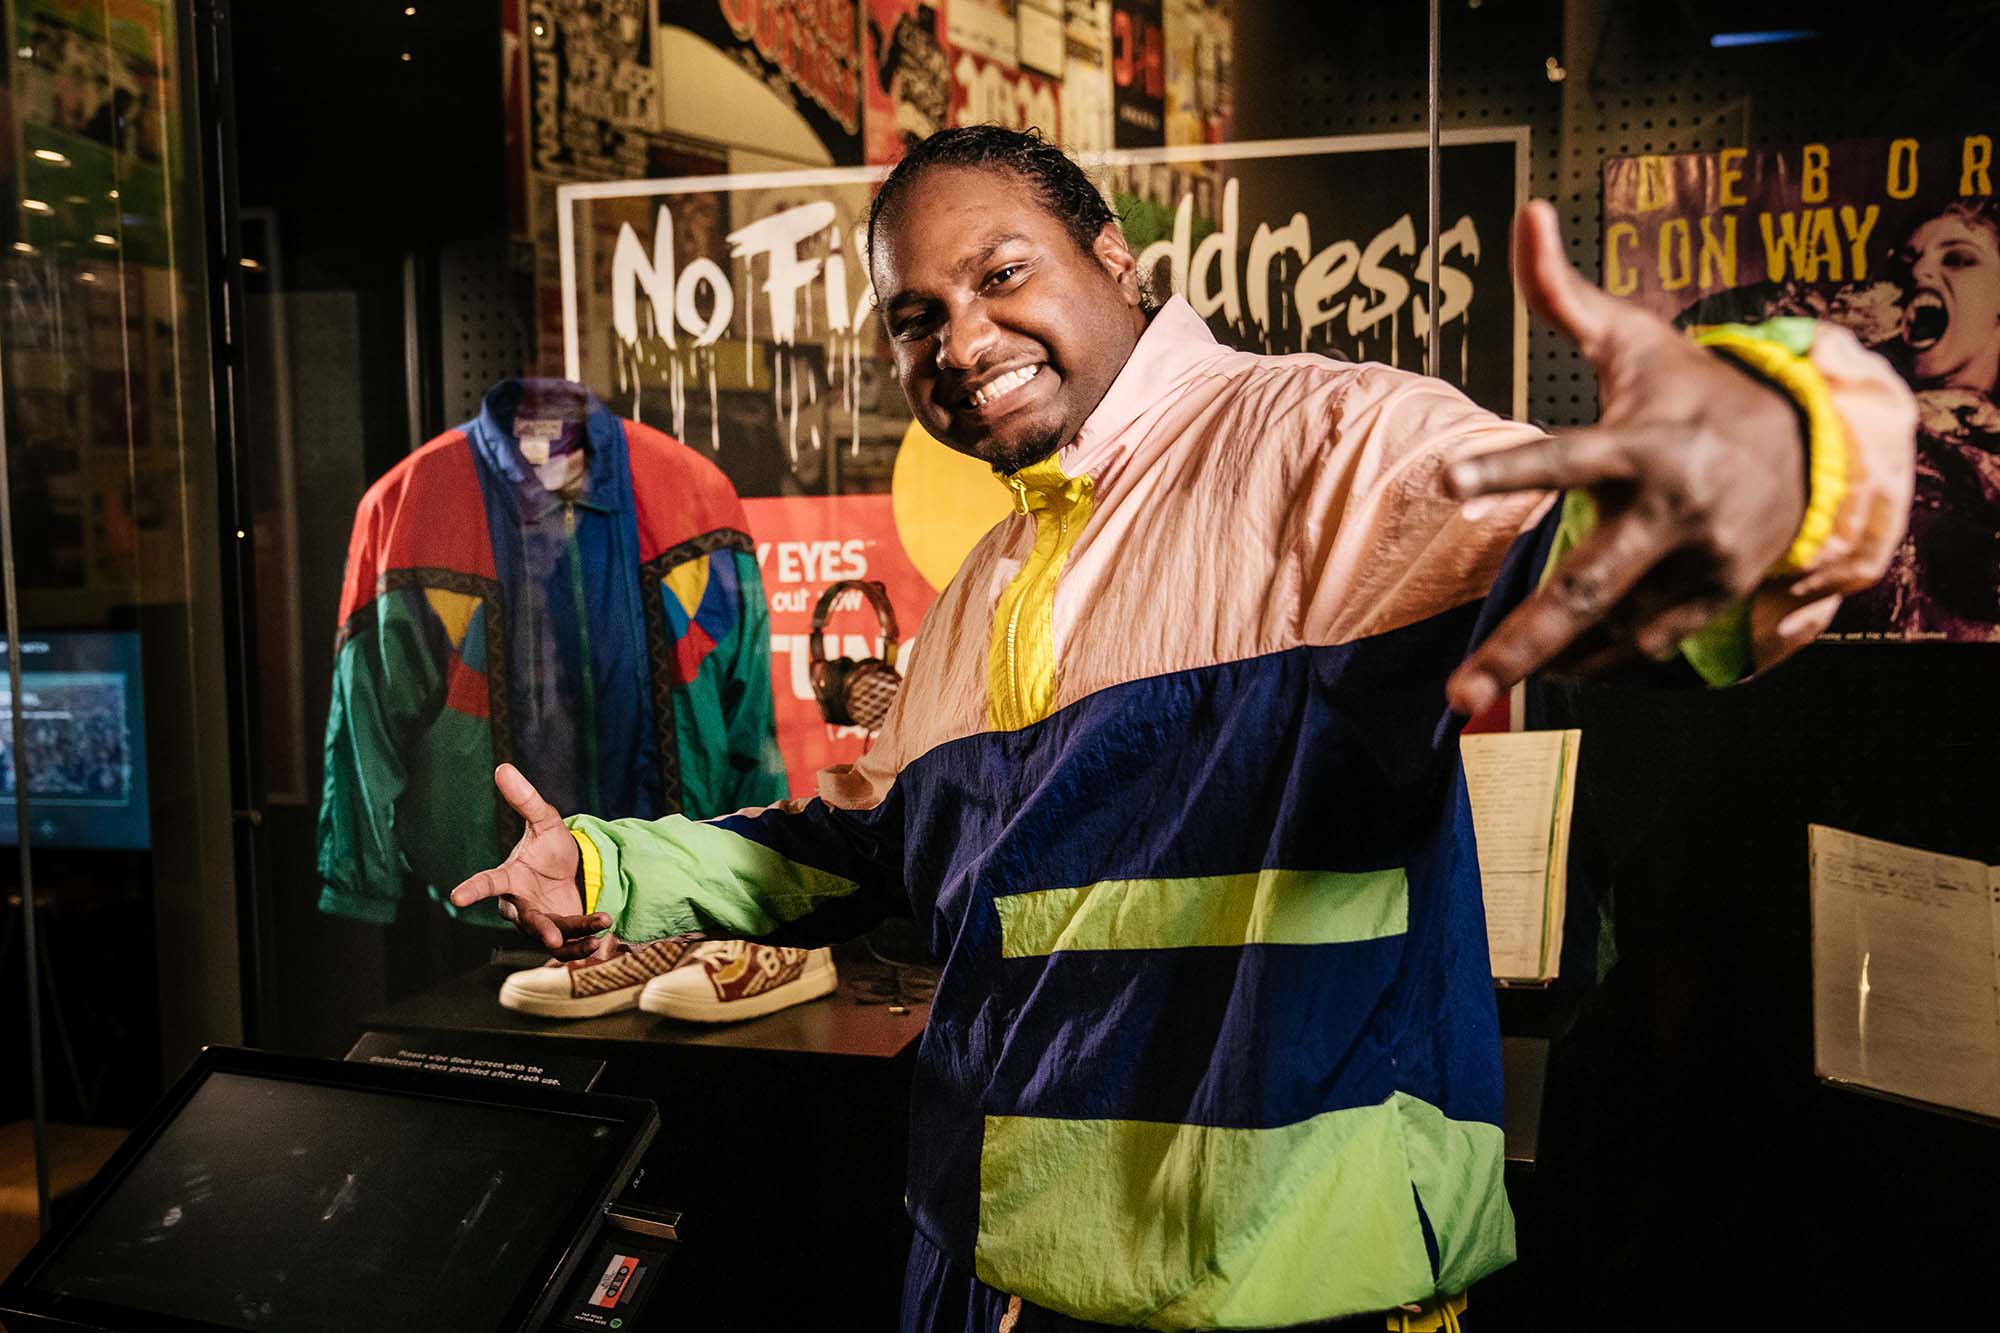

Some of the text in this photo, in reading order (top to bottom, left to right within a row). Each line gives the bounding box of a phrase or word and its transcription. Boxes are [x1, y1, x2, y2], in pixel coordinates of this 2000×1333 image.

[612, 203, 735, 352] No
[1137, 177, 1481, 346] ddress
[771, 588, 811, 612] out
[429, 1054, 449, 1063] wipe
[450, 1056, 473, 1066] down
[474, 1059, 505, 1069] screen
[506, 1062, 526, 1072] with
[527, 1065, 544, 1074] the
[449, 1065, 491, 1077] provided
[491, 1069, 517, 1080] after
[517, 1073, 540, 1083] each
[541, 1076, 561, 1086] use.
